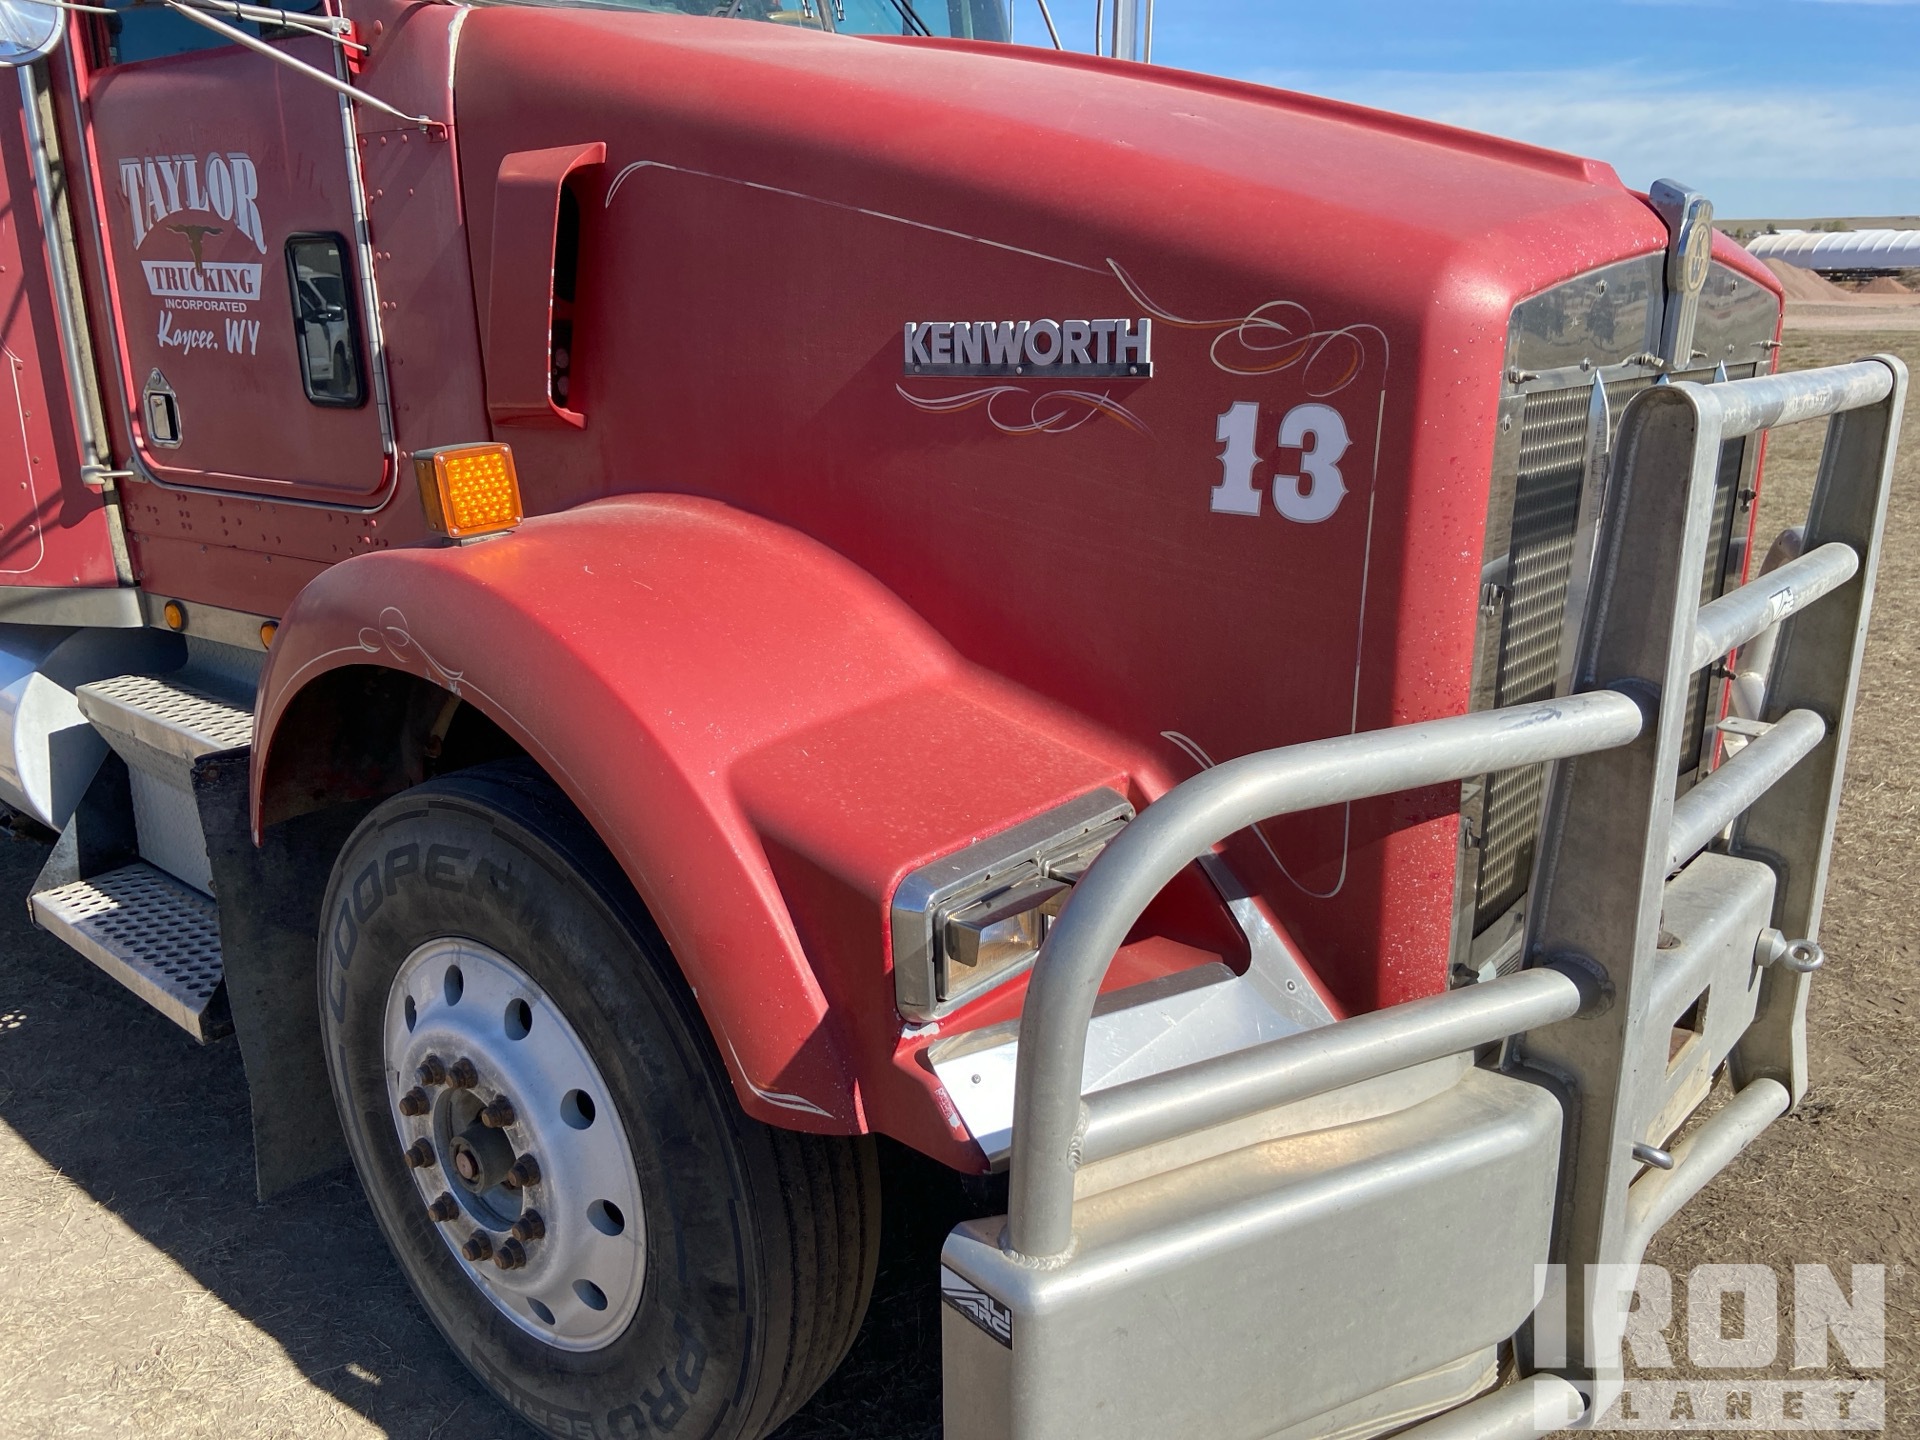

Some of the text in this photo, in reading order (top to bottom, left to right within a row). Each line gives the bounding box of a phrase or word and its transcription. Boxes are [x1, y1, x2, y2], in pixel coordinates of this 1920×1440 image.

[118, 152, 267, 254] TAYLOR
[152, 266, 254, 294] TRUCKING
[165, 298, 247, 313] INCORPORATED
[225, 317, 260, 356] WY
[904, 318, 1152, 366] KENWORTH
[1209, 400, 1354, 524] 13
[328, 842, 528, 1025] COOPER
